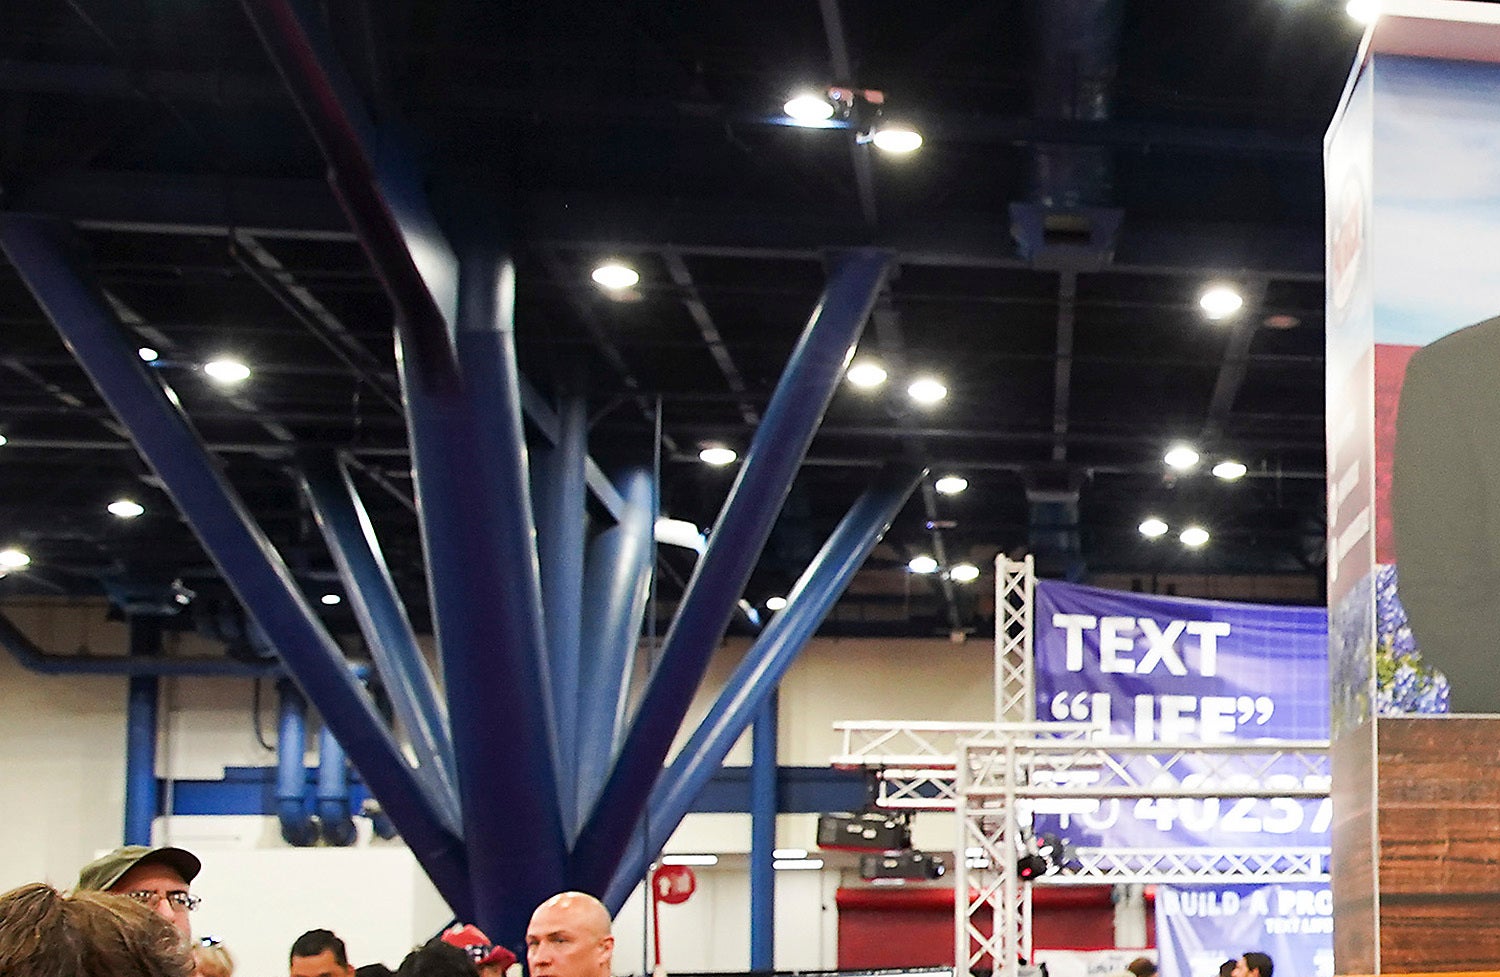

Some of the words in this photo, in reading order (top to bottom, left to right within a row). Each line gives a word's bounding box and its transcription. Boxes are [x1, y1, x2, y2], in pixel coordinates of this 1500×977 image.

[1052, 613, 1231, 677] TEXT
[1163, 891, 1240, 917] BUILD
[1250, 890, 1269, 916] A
